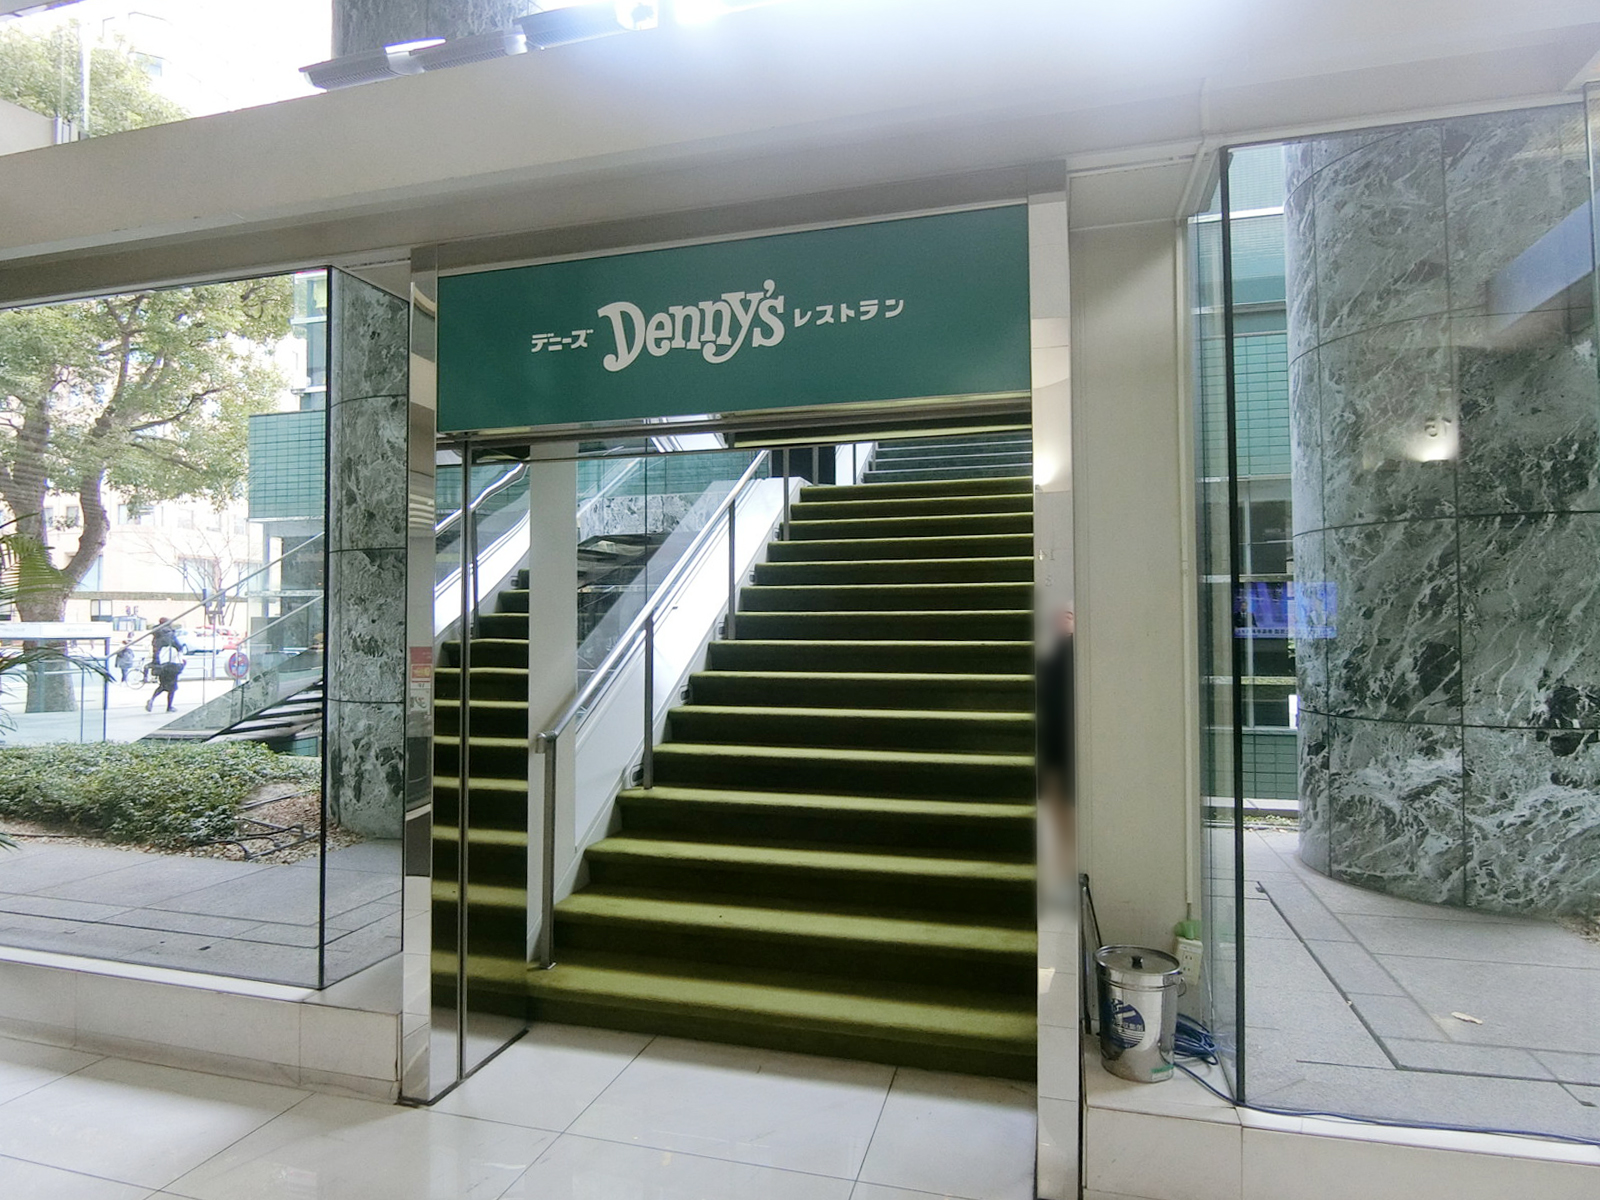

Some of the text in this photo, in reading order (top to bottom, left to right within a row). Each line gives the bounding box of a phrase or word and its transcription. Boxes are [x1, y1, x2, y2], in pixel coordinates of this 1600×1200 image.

[531, 279, 904, 372] デニーズ Denny's レストラン
